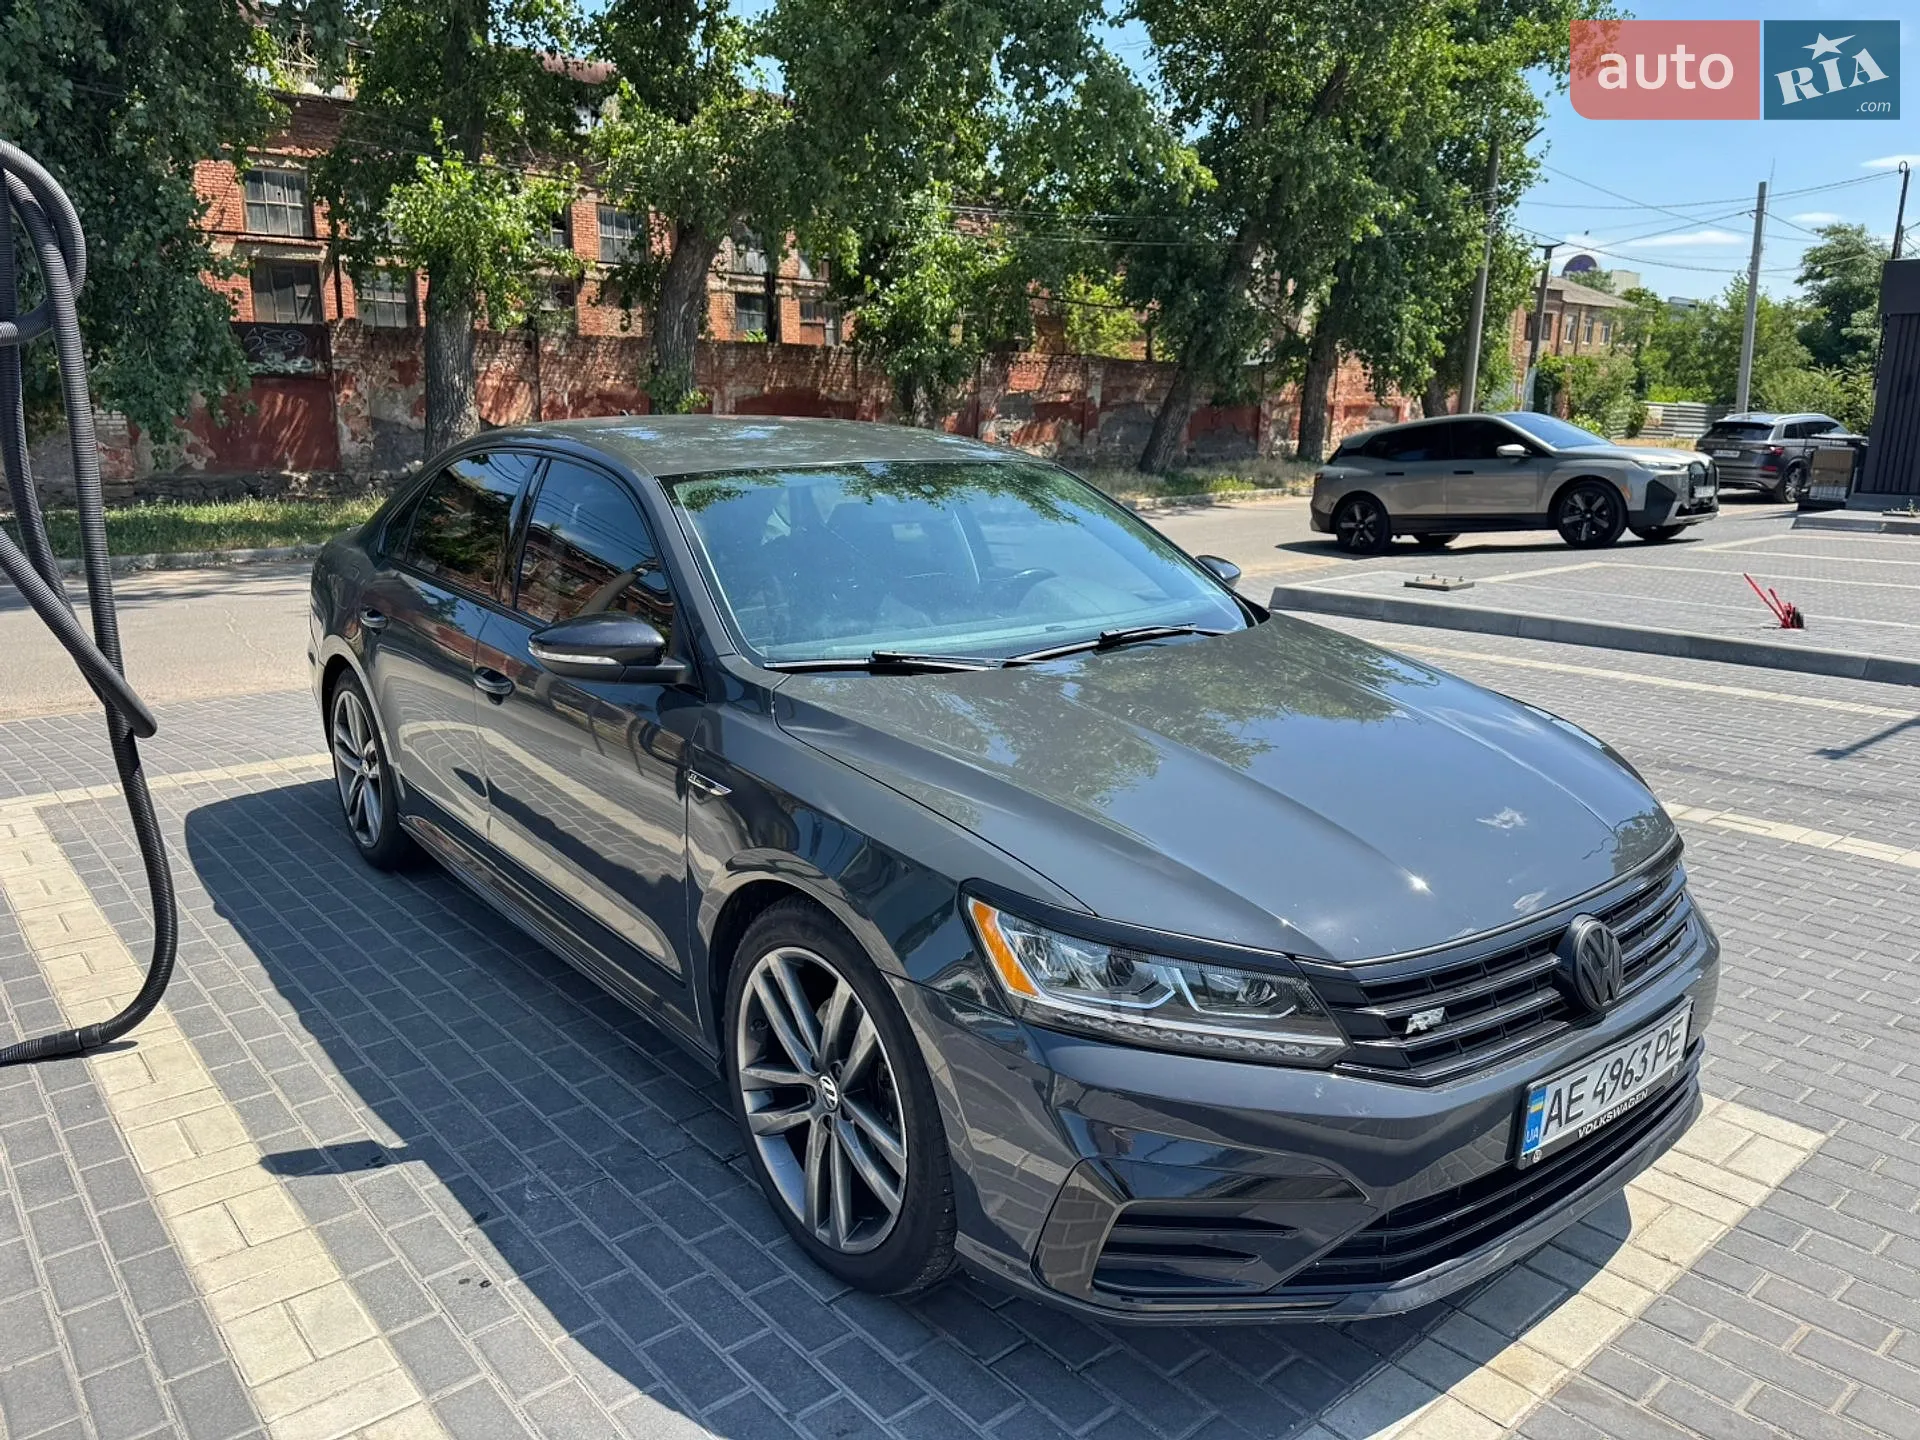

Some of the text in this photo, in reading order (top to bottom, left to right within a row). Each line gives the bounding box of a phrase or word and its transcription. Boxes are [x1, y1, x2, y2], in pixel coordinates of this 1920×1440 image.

[1543, 1015, 1684, 1137] AE 4963 PE
[1525, 1127, 1540, 1144] UA
[1577, 1088, 1649, 1139] VOLKSWAGEN
